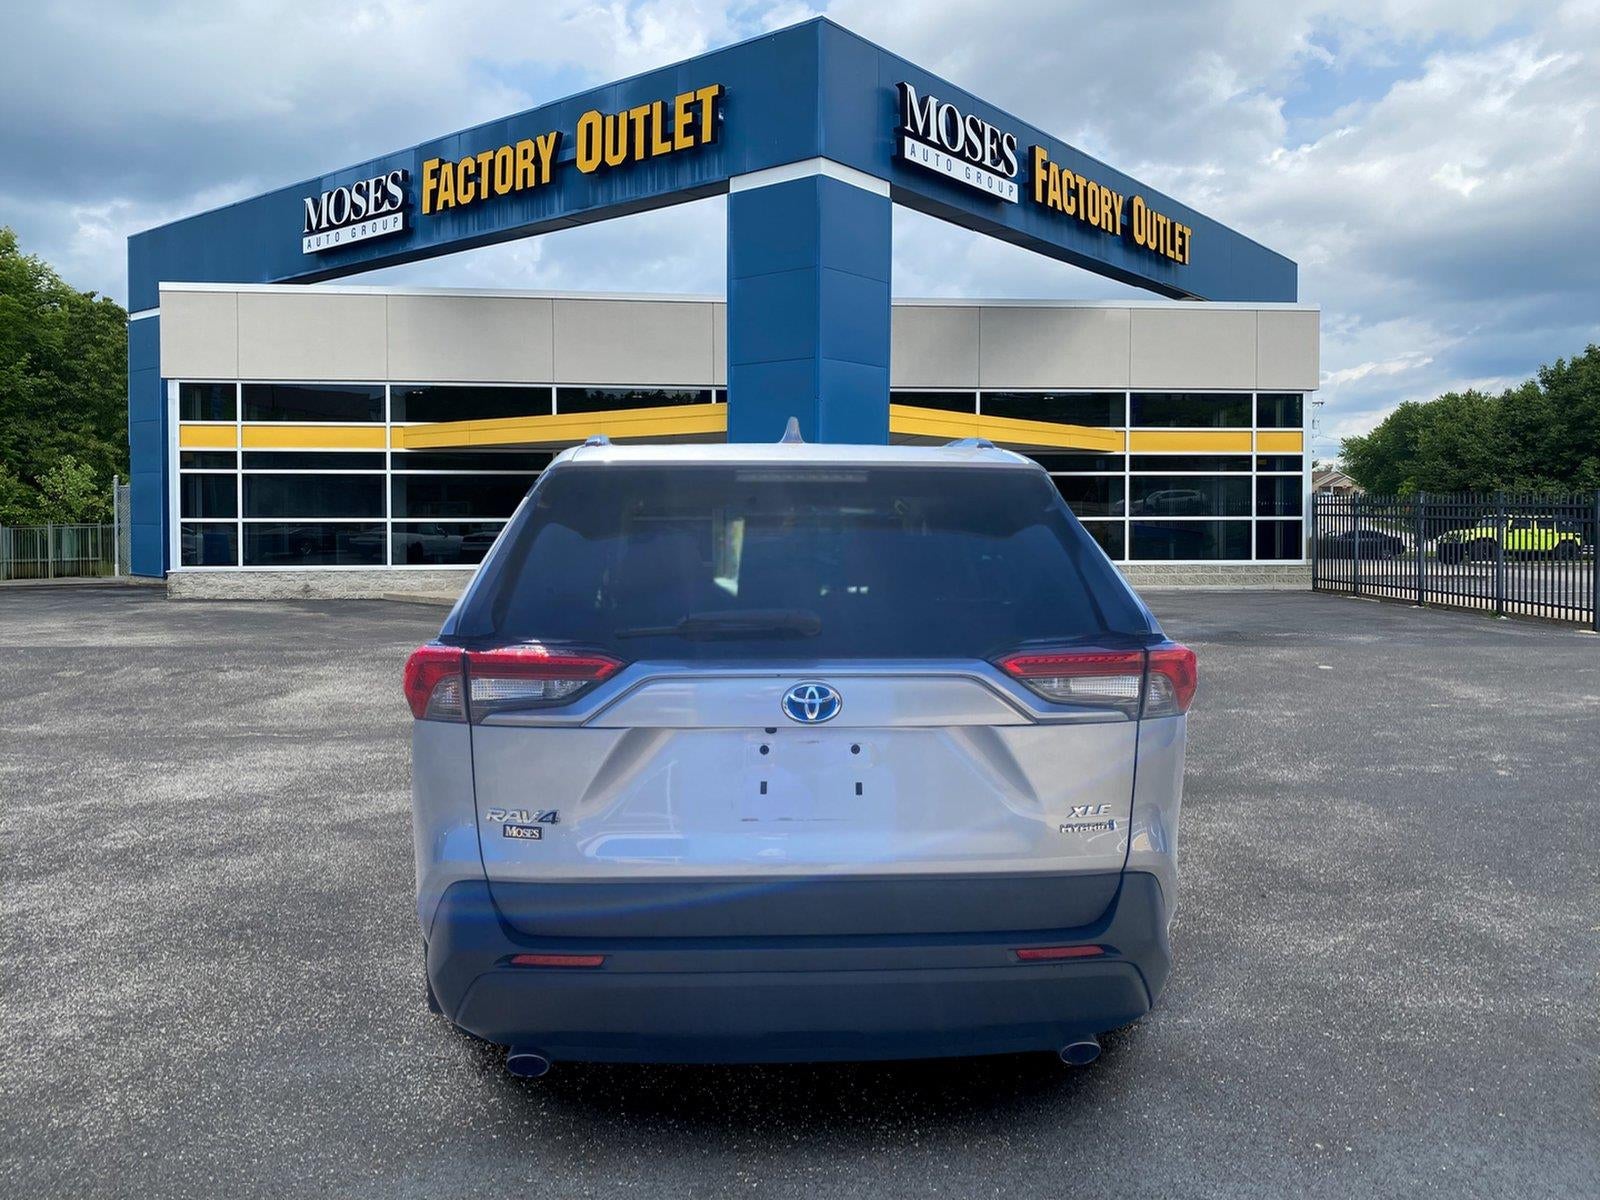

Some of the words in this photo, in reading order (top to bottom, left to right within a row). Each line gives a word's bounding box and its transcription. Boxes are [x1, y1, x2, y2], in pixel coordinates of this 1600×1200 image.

[422, 131, 558, 215] FACTORY
[576, 83, 720, 174] OUTLET
[904, 82, 1018, 178] MOSES
[909, 142, 953, 172] AUTO
[964, 166, 1015, 197] GROUP
[303, 169, 403, 232] MOSES
[1034, 145, 1124, 236] FACTORY
[1132, 194, 1192, 265] OUTLET
[306, 231, 340, 249] AUTO
[350, 216, 399, 238] GROUP
[486, 808, 560, 824] RAV4
[505, 826, 539, 838] MOSES
[1066, 803, 1111, 818] XLE
